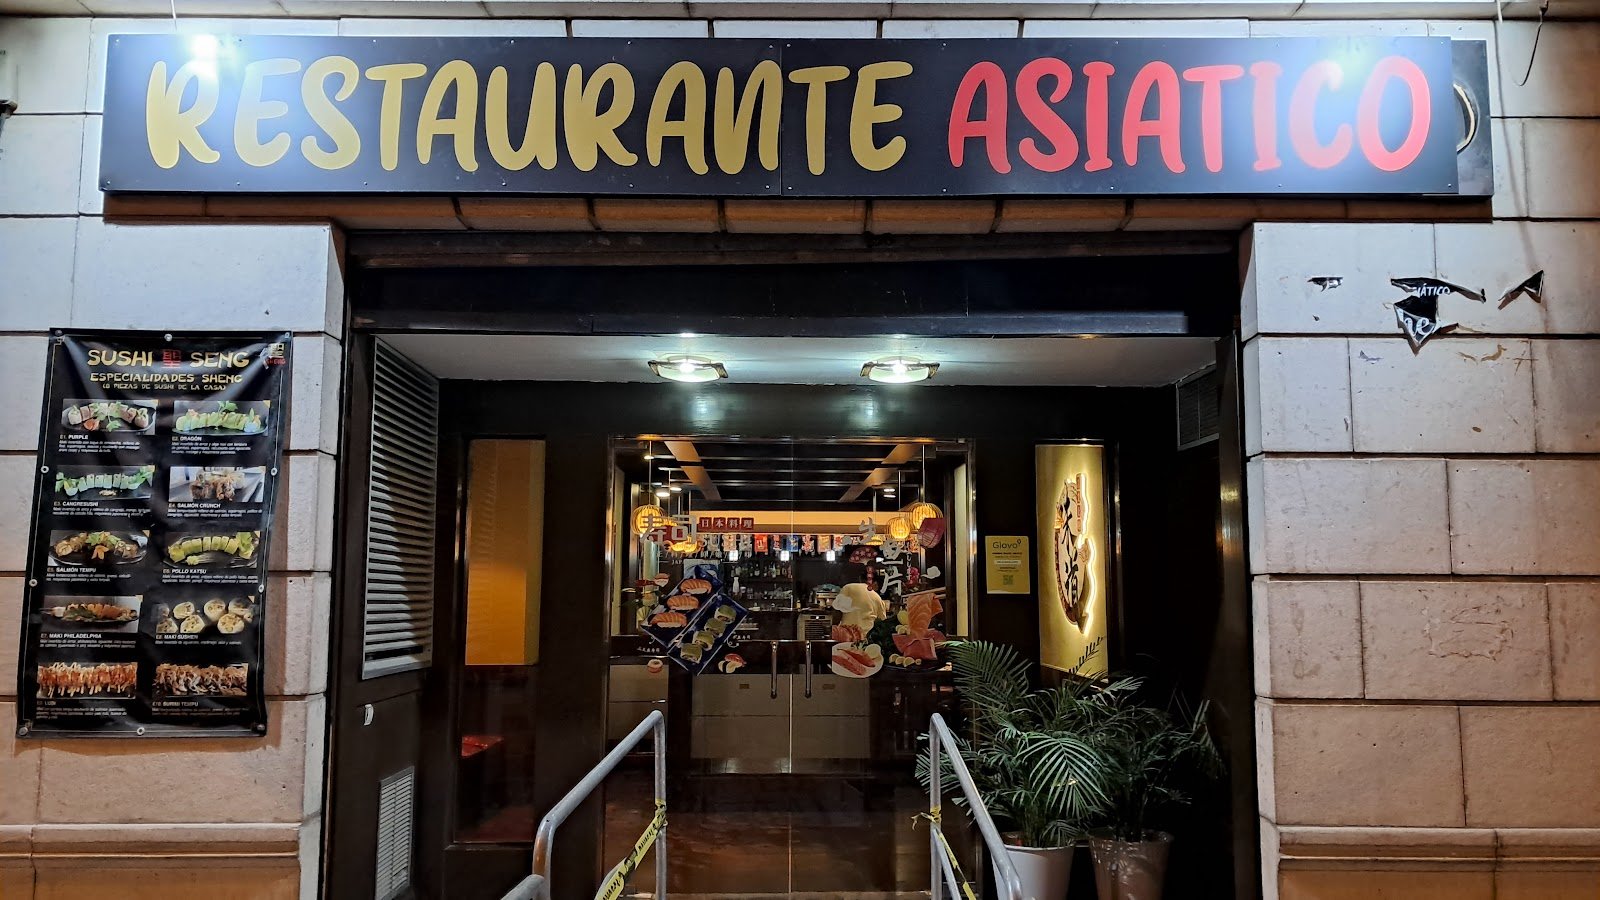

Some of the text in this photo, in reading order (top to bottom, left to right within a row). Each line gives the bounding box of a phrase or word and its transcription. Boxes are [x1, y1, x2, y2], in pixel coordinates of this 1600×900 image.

[146, 55, 1431, 174] RESTAURANTE ASIATICO
[87, 349, 153, 367] SUSHI
[189, 351, 250, 369] SENG
[90, 372, 243, 384] ESPECIALIDADES SHENG
[700, 518, 753, 529] 日本料理
[992, 541, 1018, 549] Glovo
